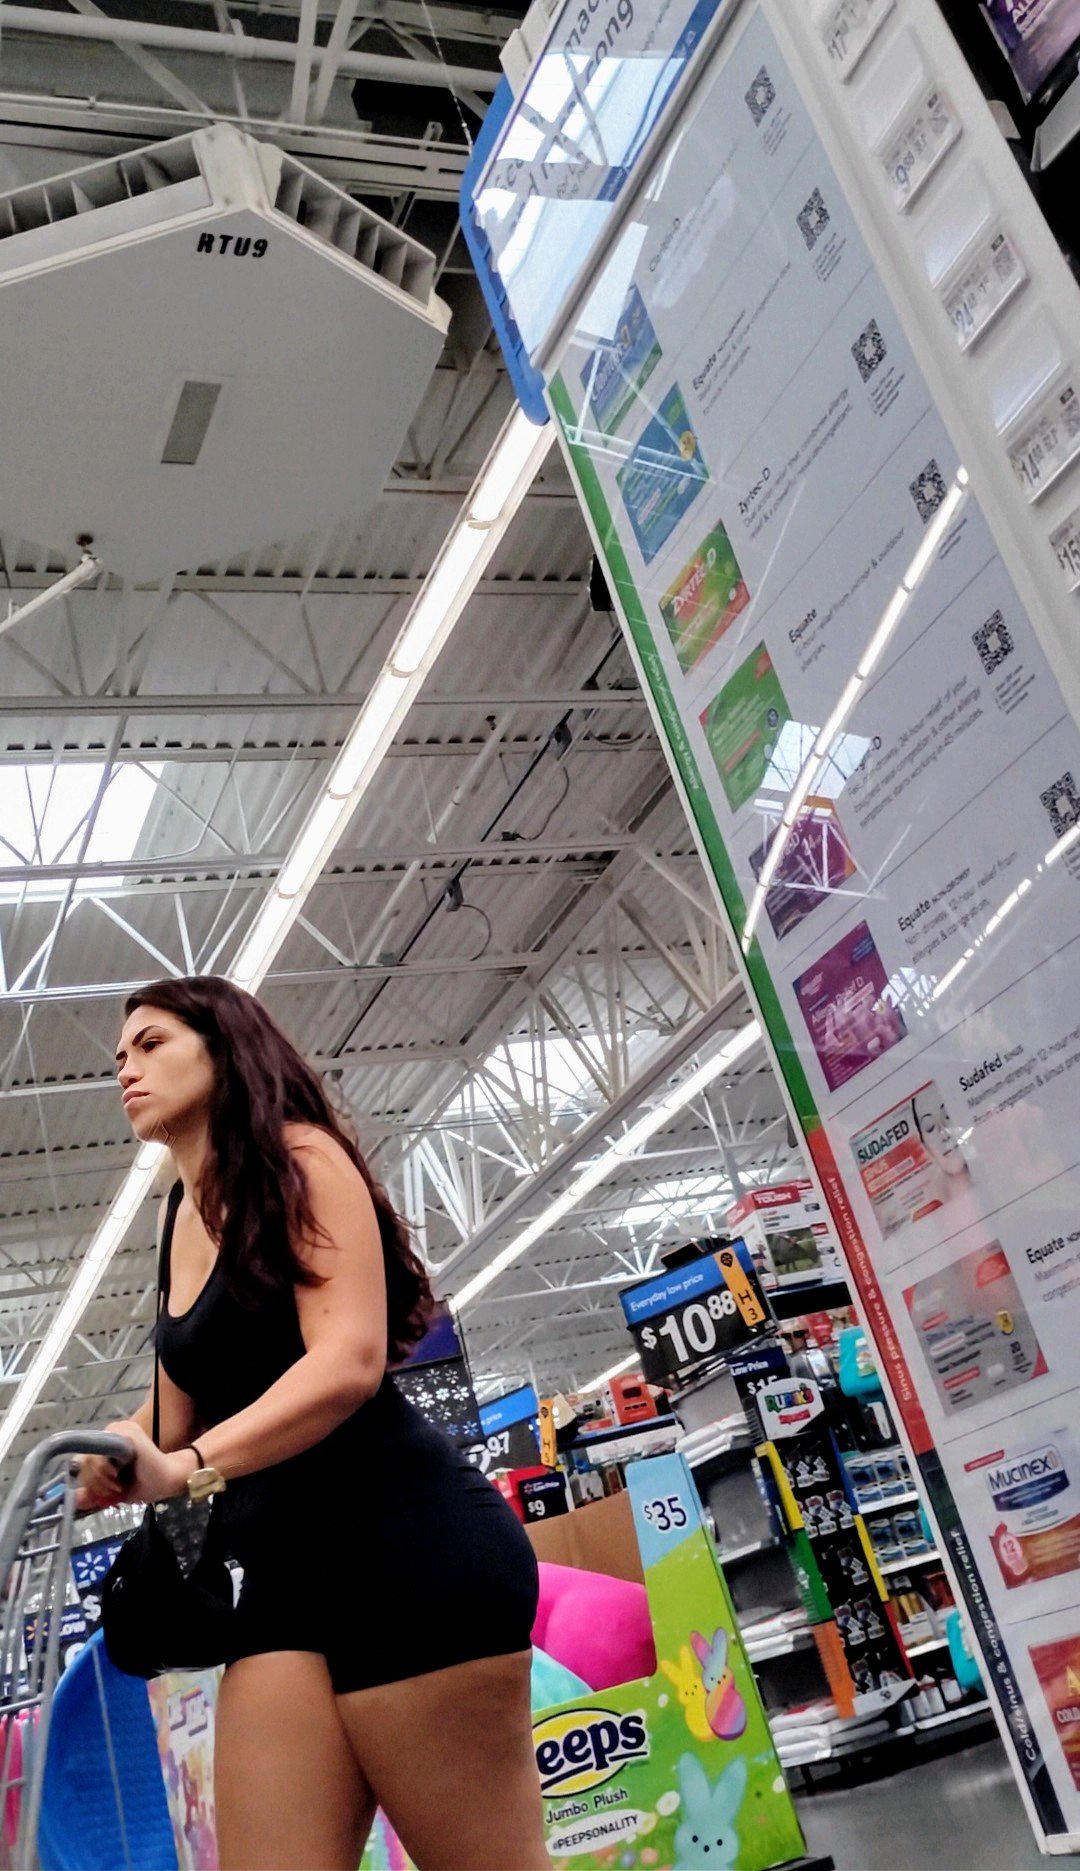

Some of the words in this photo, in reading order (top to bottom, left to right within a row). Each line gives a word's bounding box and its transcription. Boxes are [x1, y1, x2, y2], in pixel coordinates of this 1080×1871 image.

[197, 232, 268, 258] RTU9
[787, 604, 818, 646] Equate
[896, 895, 932, 935] Equate
[956, 1053, 1004, 1091] Sudafed
[855, 1117, 910, 1165] SUDAFED
[826, 1174, 846, 1213] relief
[839, 1210, 873, 1289] congestion
[1026, 1237, 1065, 1264] Equate
[630, 1288, 667, 1312] Everyday
[666, 1284, 682, 1295] low
[682, 1274, 703, 1290] price
[866, 1286, 877, 1302] &
[870, 1300, 899, 1363] pressure
[892, 1361, 912, 1403] Sinus
[985, 1451, 1052, 1491] Mucinex
[643, 1496, 688, 1532] $35
[947, 1525, 971, 1571] relief
[963, 1569, 1003, 1660] congestion
[993, 1660, 1008, 1676] &
[998, 1674, 1038, 1763] Cold/sinus
[534, 1715, 647, 1776] eeps
[546, 1803, 588, 1824] Jumbo
[593, 1788, 628, 1809] Plush
[553, 1814, 639, 1850] #PEEPSONALITY
